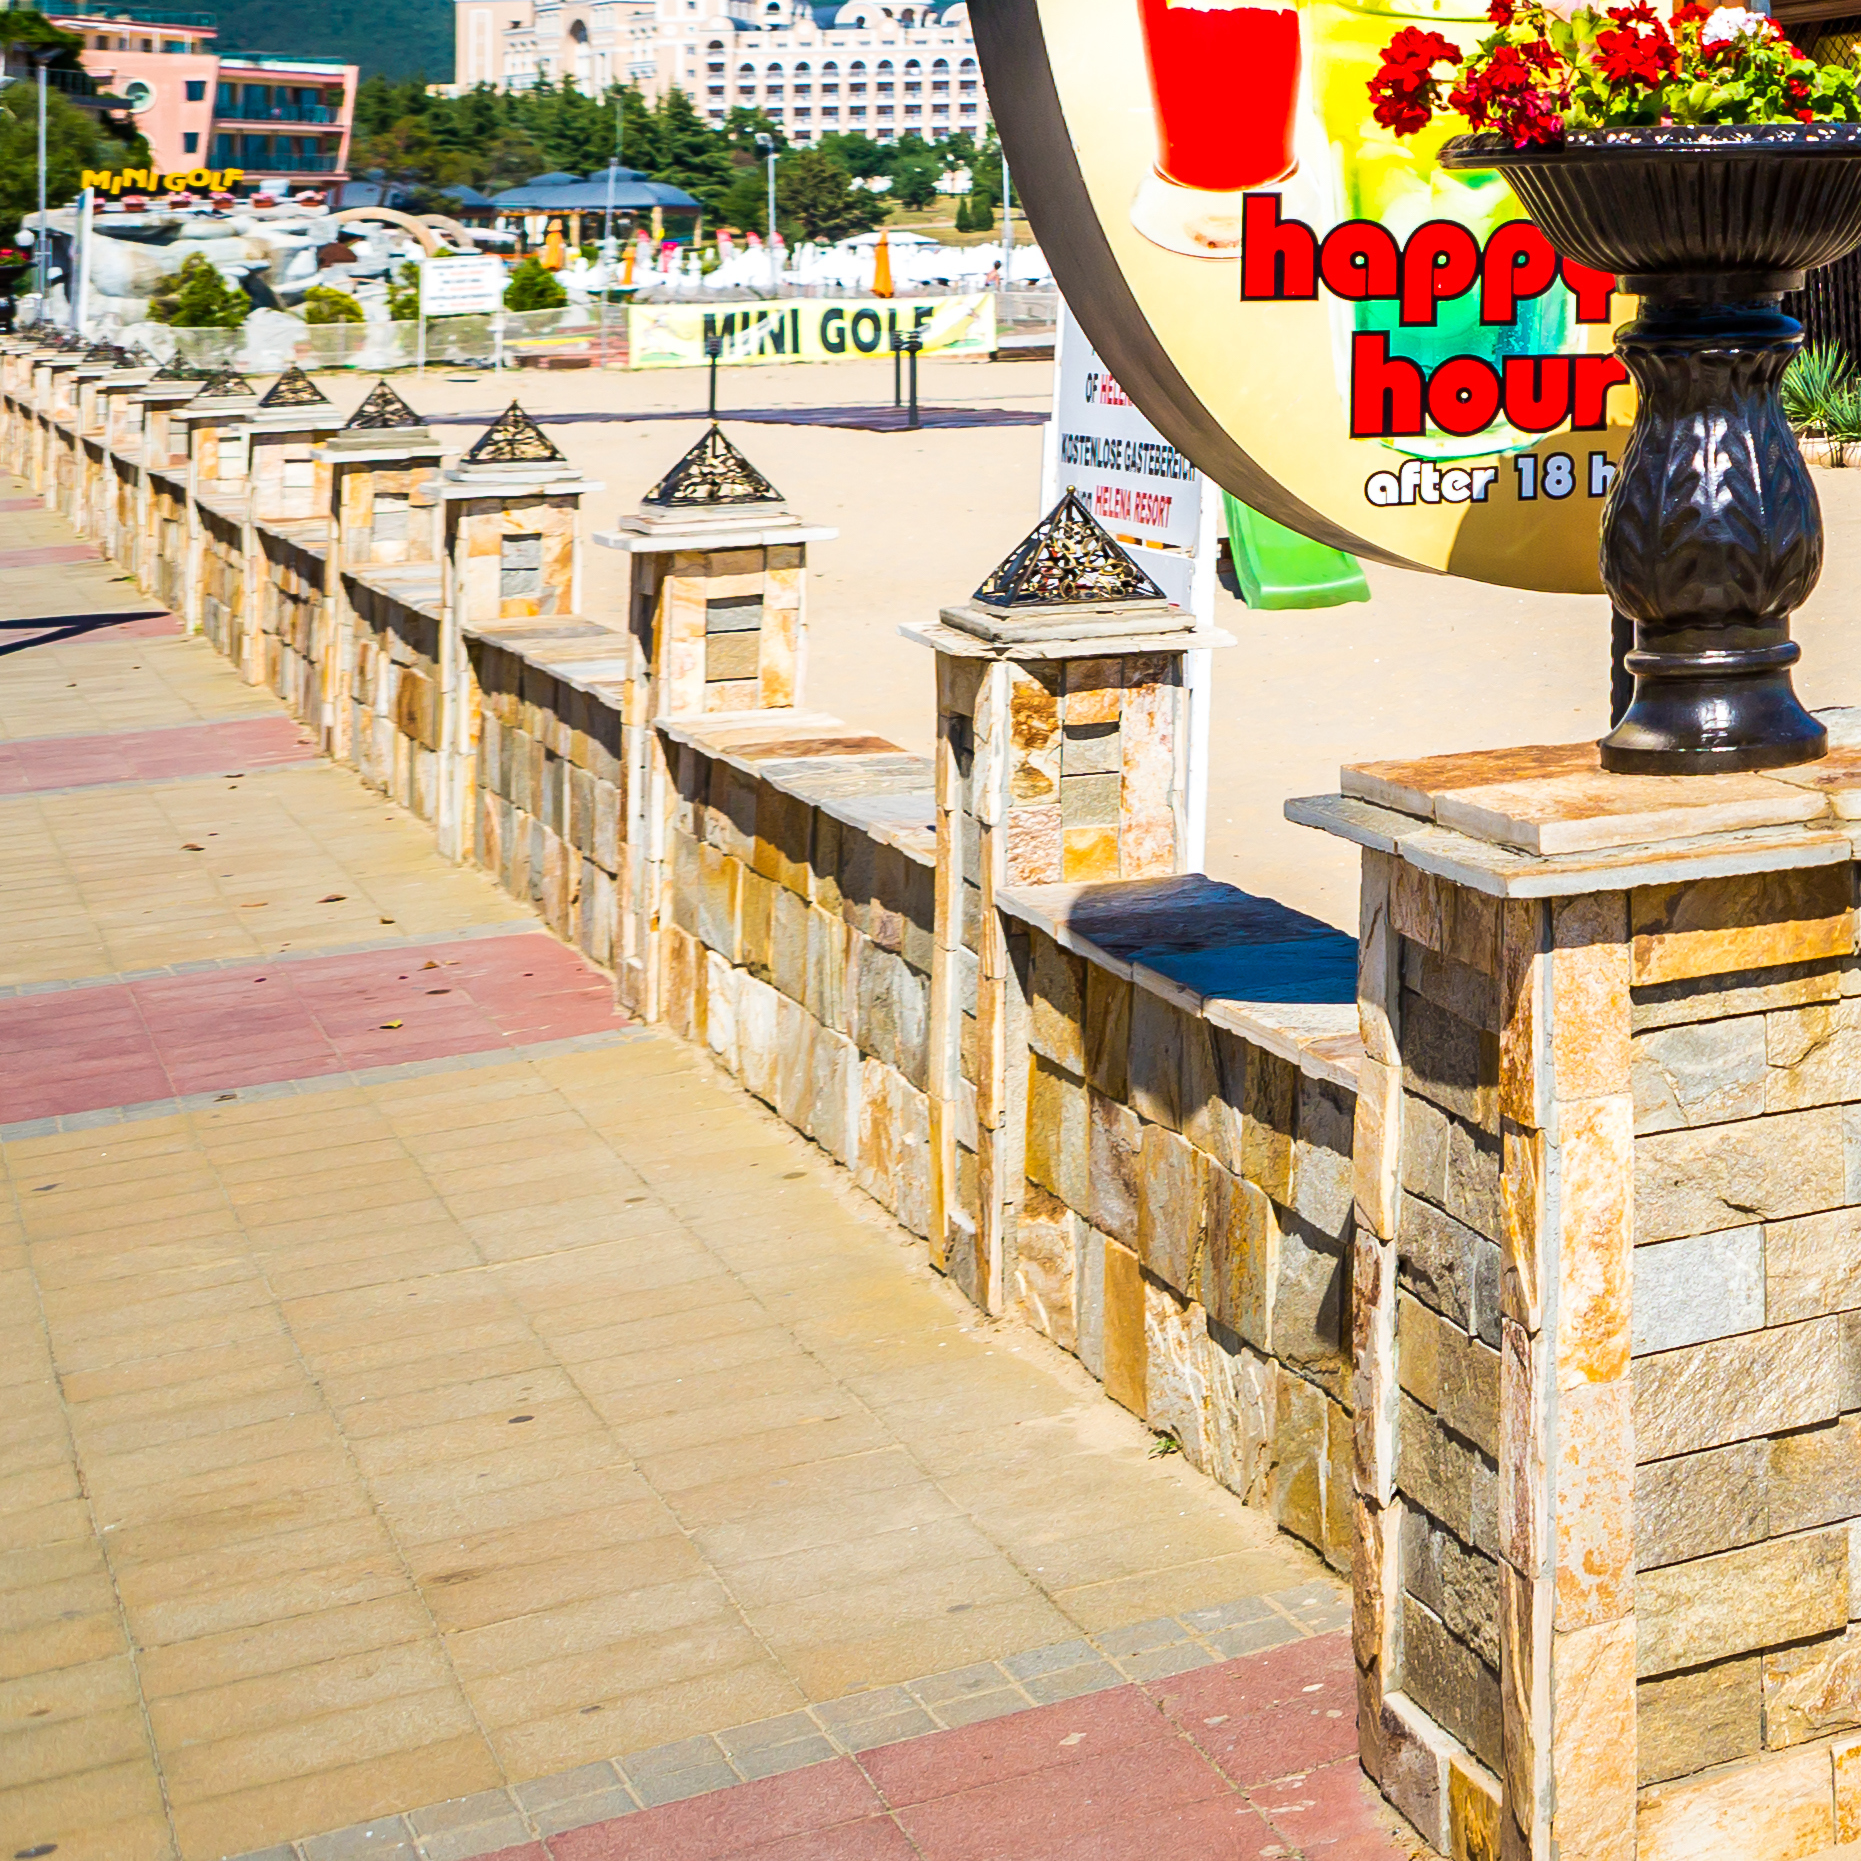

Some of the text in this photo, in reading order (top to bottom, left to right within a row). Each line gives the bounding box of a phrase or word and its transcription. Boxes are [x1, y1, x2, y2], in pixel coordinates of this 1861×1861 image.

[81, 168, 245, 195] MINI GOLF
[703, 306, 934, 357] MINI GOLF
[1085, 373, 1099, 403] OF
[1350, 330, 1630, 439] hour
[1061, 433, 1123, 471] KOSTENLOSE
[1365, 458, 1498, 507] after
[1515, 452, 1576, 501] 18
[1095, 485, 1131, 522] HELENA
[1133, 491, 1173, 529] RESORT
